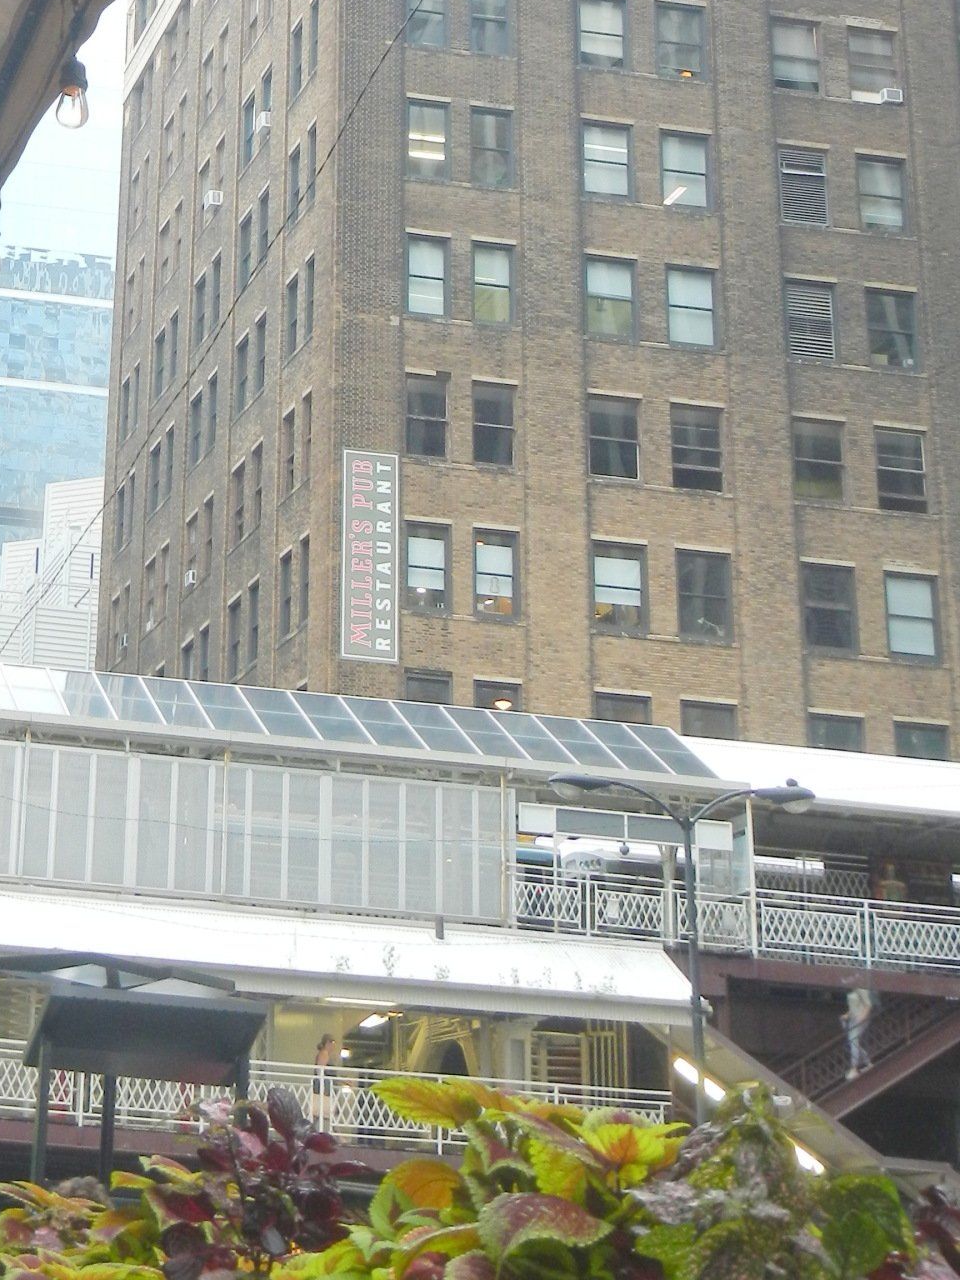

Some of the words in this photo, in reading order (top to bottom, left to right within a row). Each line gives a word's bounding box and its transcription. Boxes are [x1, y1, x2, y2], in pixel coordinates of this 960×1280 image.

[351, 459, 374, 510] PUB
[349, 519, 374, 648] MILLER'S
[375, 461, 392, 651] RESTAURANT
